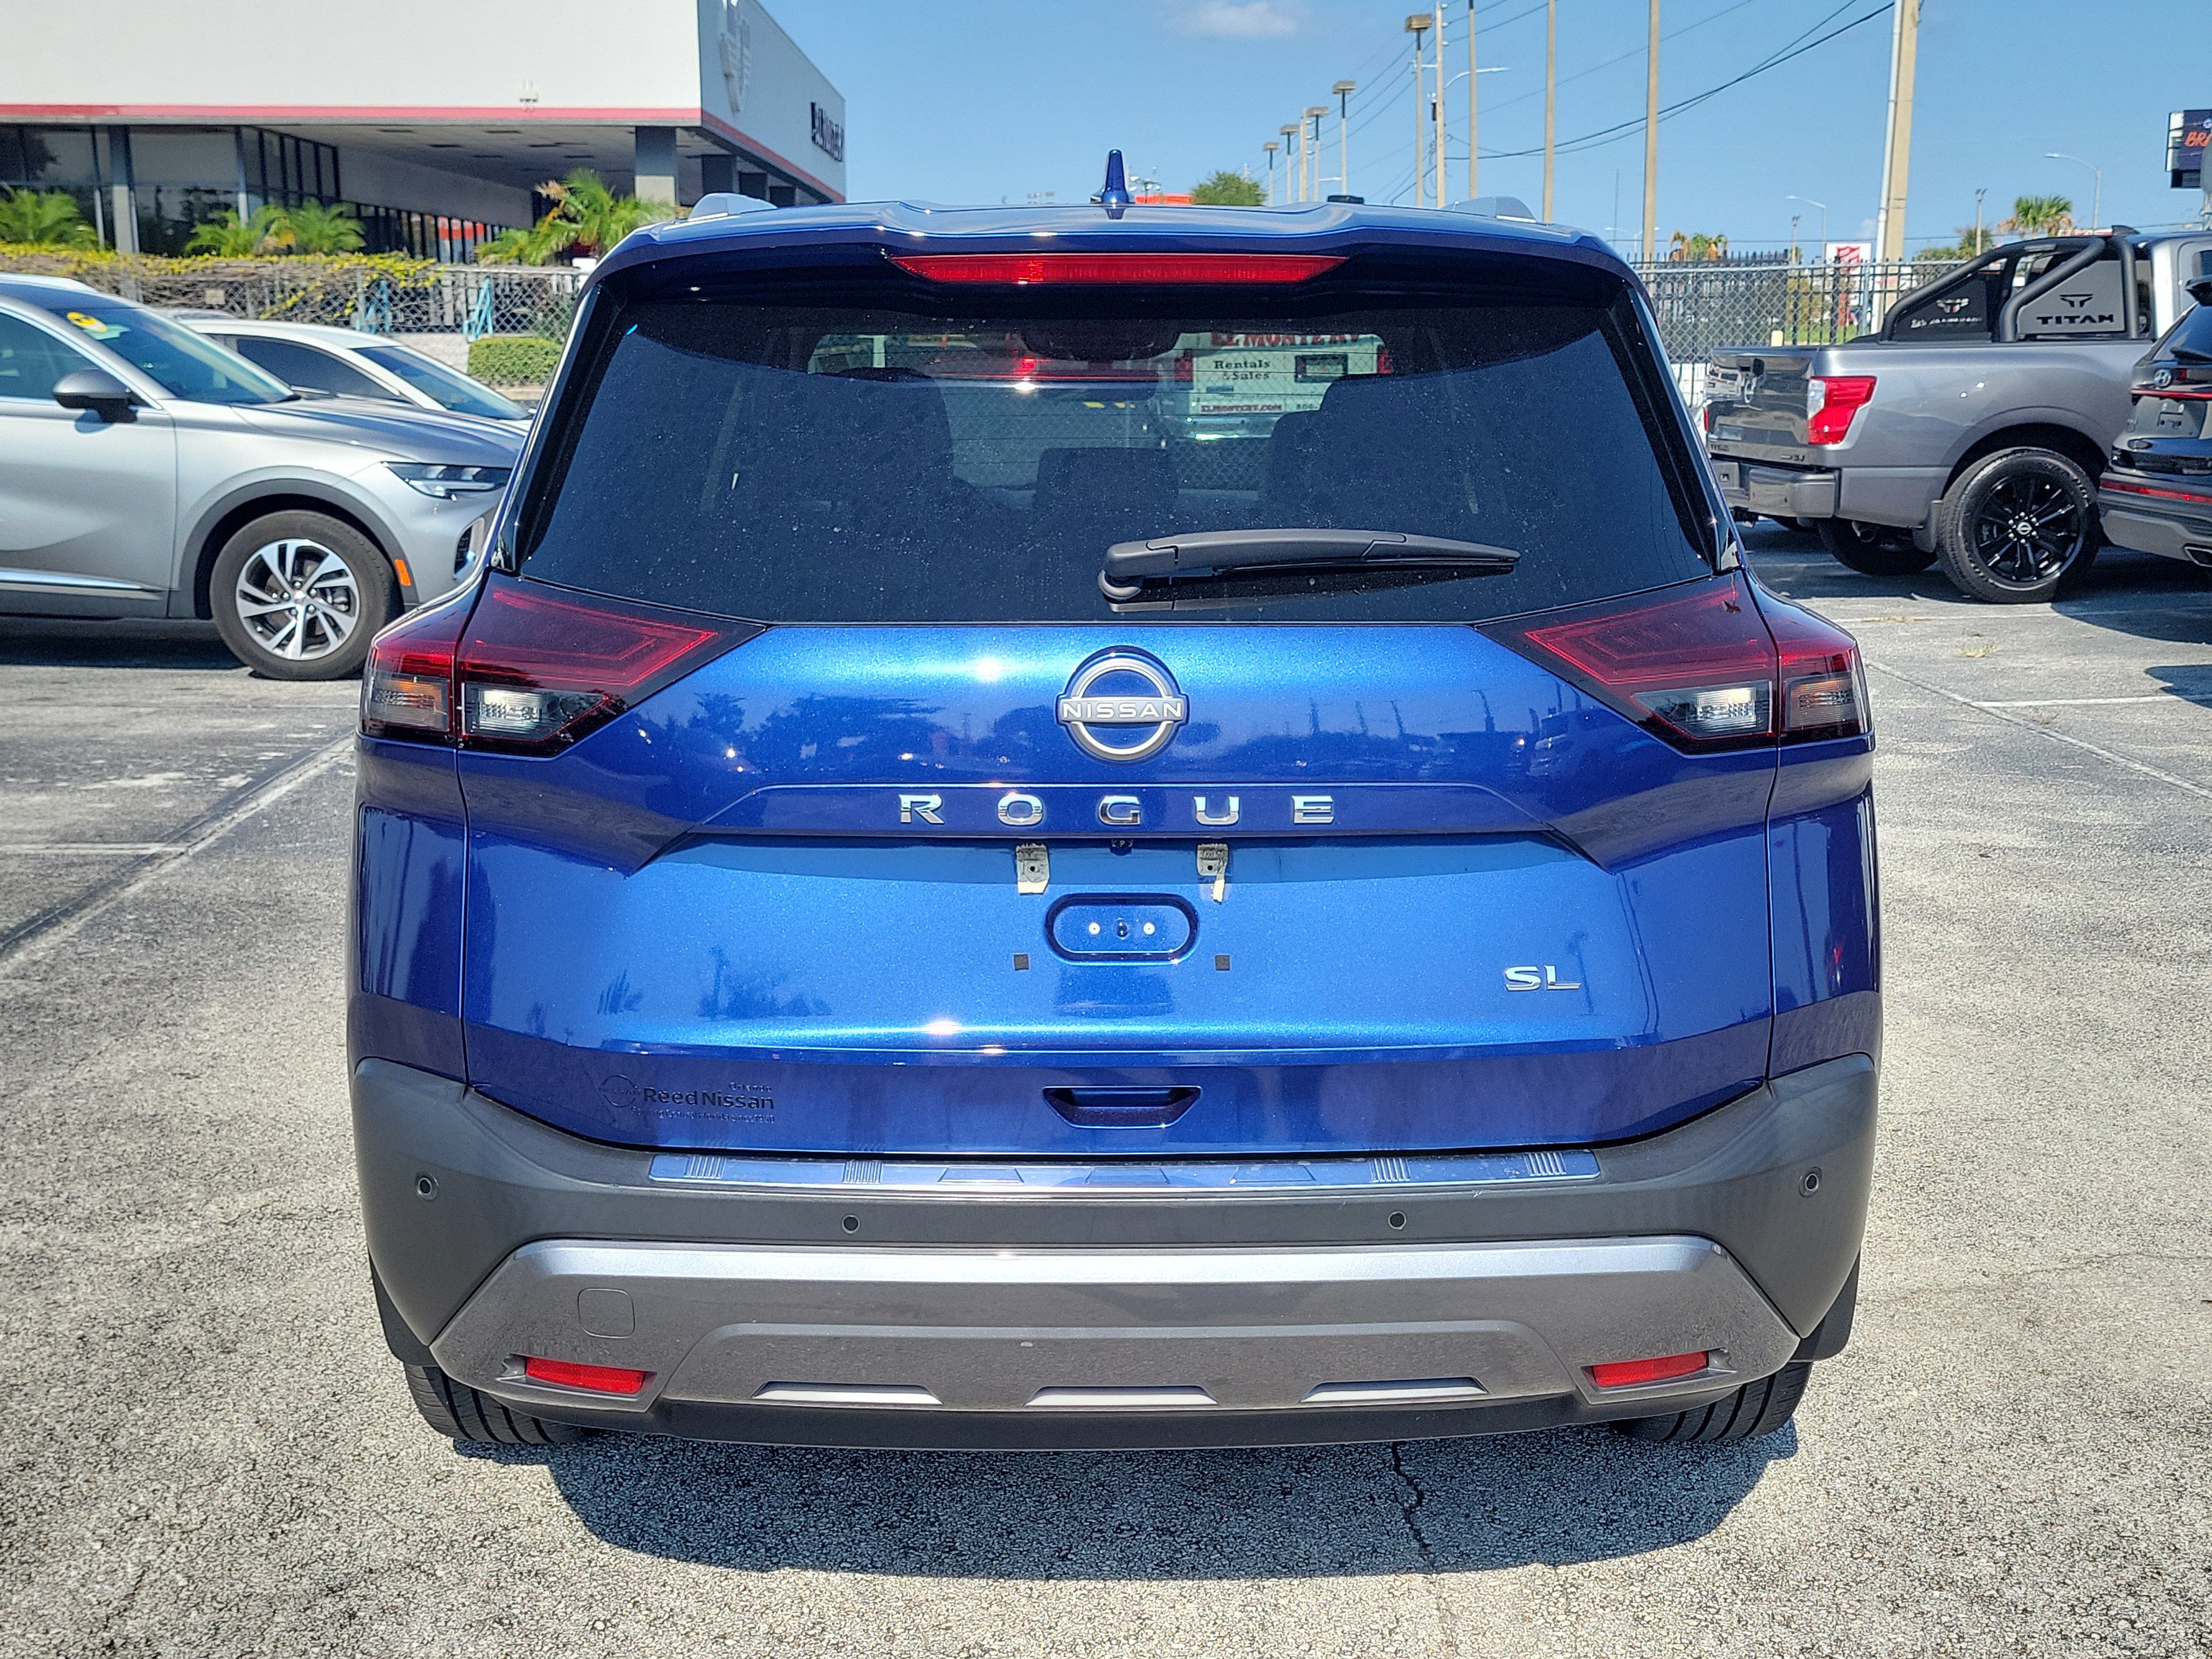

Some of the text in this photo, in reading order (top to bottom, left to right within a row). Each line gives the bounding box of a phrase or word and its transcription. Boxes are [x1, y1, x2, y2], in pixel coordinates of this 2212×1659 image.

[2036, 314, 2114, 325] TITAN
[1214, 359, 1271, 369] Rentals
[1063, 703, 1183, 719] NISSAN
[899, 794, 1335, 825] ROGUE
[1505, 965, 1582, 991] SL
[643, 1086, 698, 1105] Reed
[702, 1090, 775, 1109] Nissan
